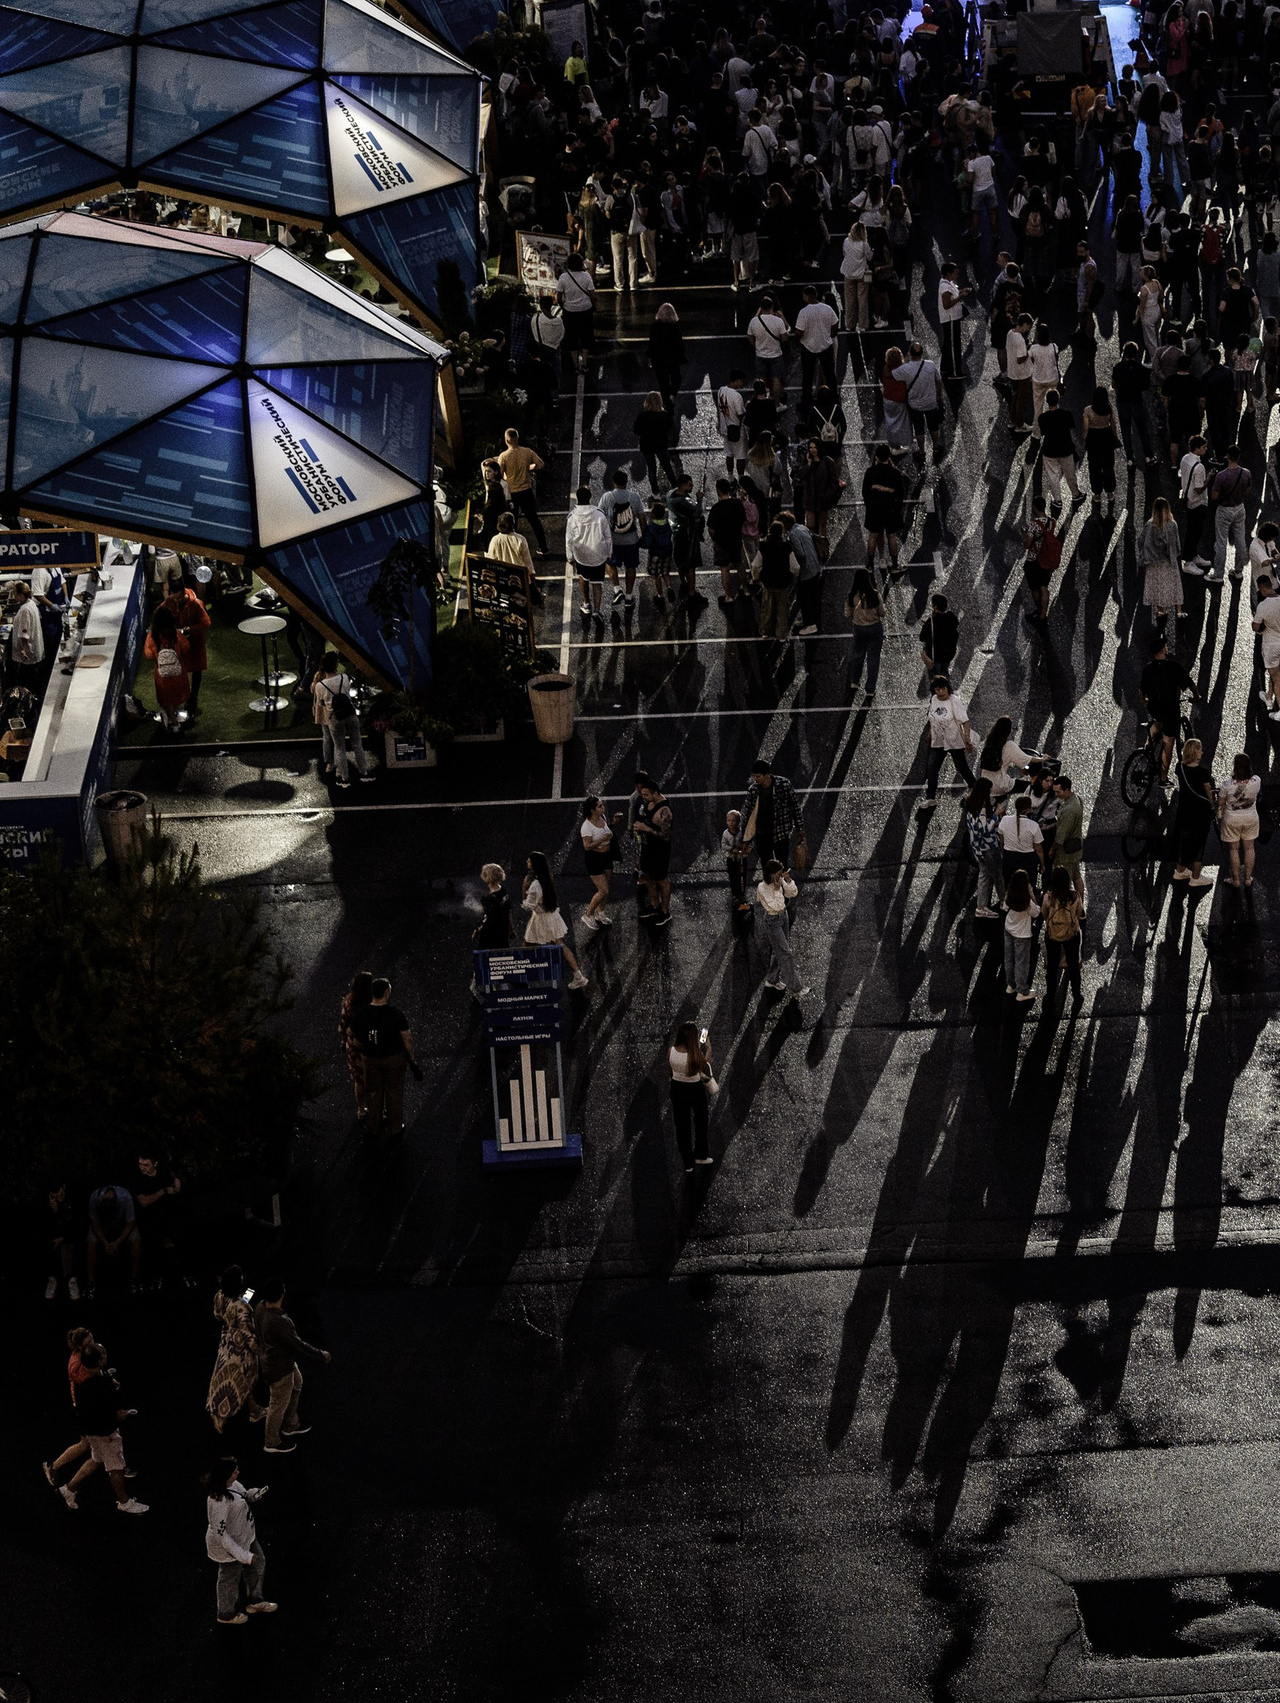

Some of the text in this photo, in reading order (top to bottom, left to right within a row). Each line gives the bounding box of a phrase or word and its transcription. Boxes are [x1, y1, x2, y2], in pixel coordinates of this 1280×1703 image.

[333, 98, 399, 187] УРБАНИСТИЧЕСКИЙ
[345, 127, 392, 189] МОСКОВСКИЙ
[379, 151, 406, 185] ФОРУМ
[261, 398, 339, 508] УРБАНИСТИЧЕСКИЙ
[273, 435, 330, 511] МОСКОВСКИЙ
[315, 463, 347, 505] ФОРУМ
[0, 543, 60, 556] РАТОРГ
[489, 958, 531, 966] МОСКОВСКИЙ
[489, 962, 549, 971] УРБАНИСТИЧЕСКИЙ
[497, 995, 524, 1003] МОДНЫЙ
[495, 1034, 535, 1042] НАСТОЛЬНЫЕ
